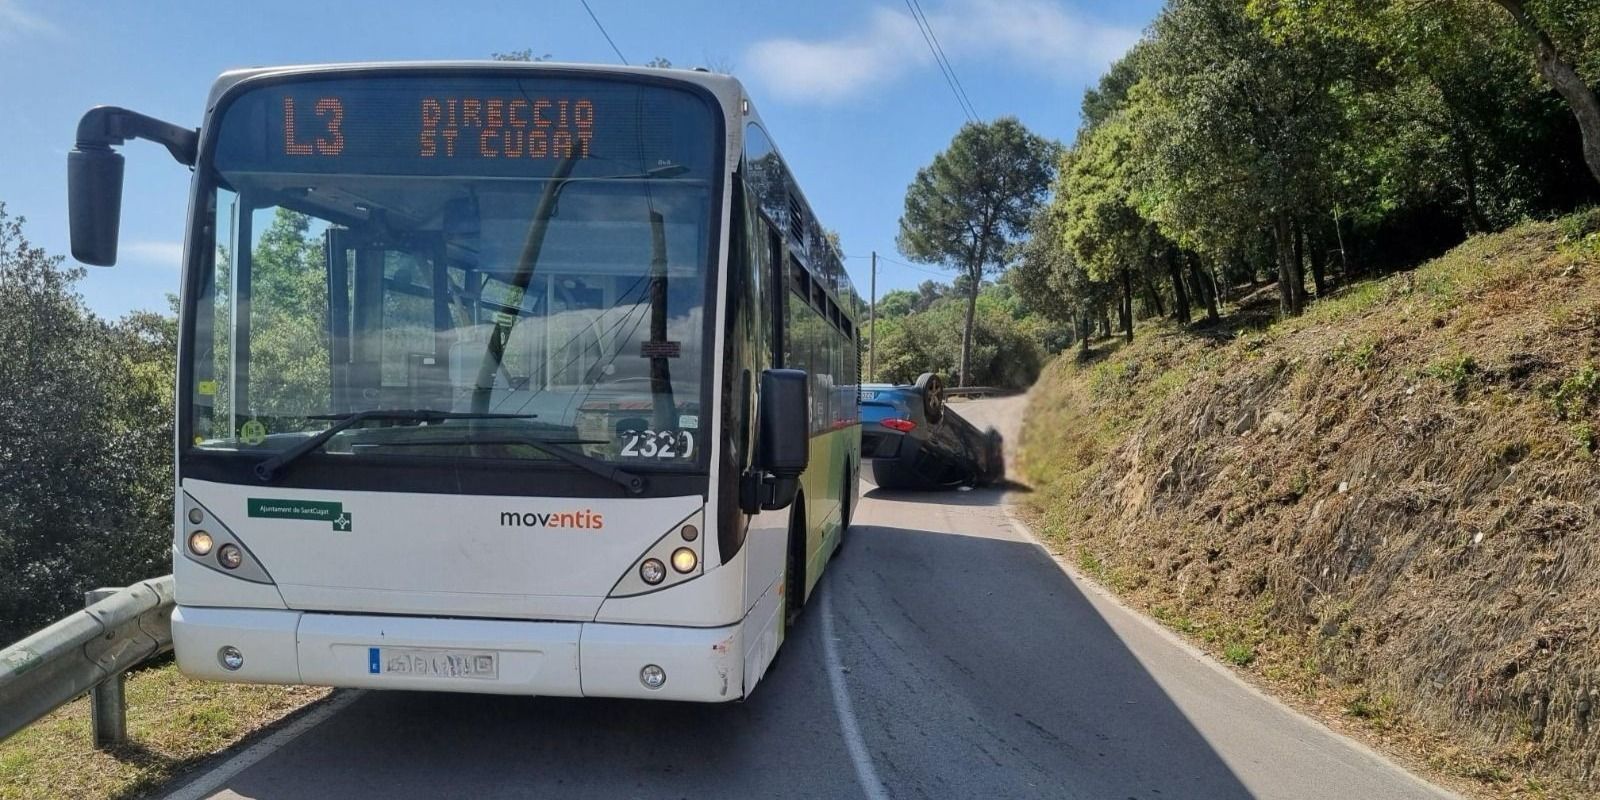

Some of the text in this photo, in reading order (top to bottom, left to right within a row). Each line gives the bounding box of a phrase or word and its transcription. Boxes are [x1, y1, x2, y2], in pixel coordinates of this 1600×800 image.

[284, 97, 343, 155] L3
[422, 98, 593, 128] DIRECCIO
[420, 130, 593, 158] ST CUGAT
[620, 429, 694, 458] 2320
[260, 505, 292, 513] Ajuntament
[292, 505, 300, 513] de
[500, 509, 603, 529] moventis
